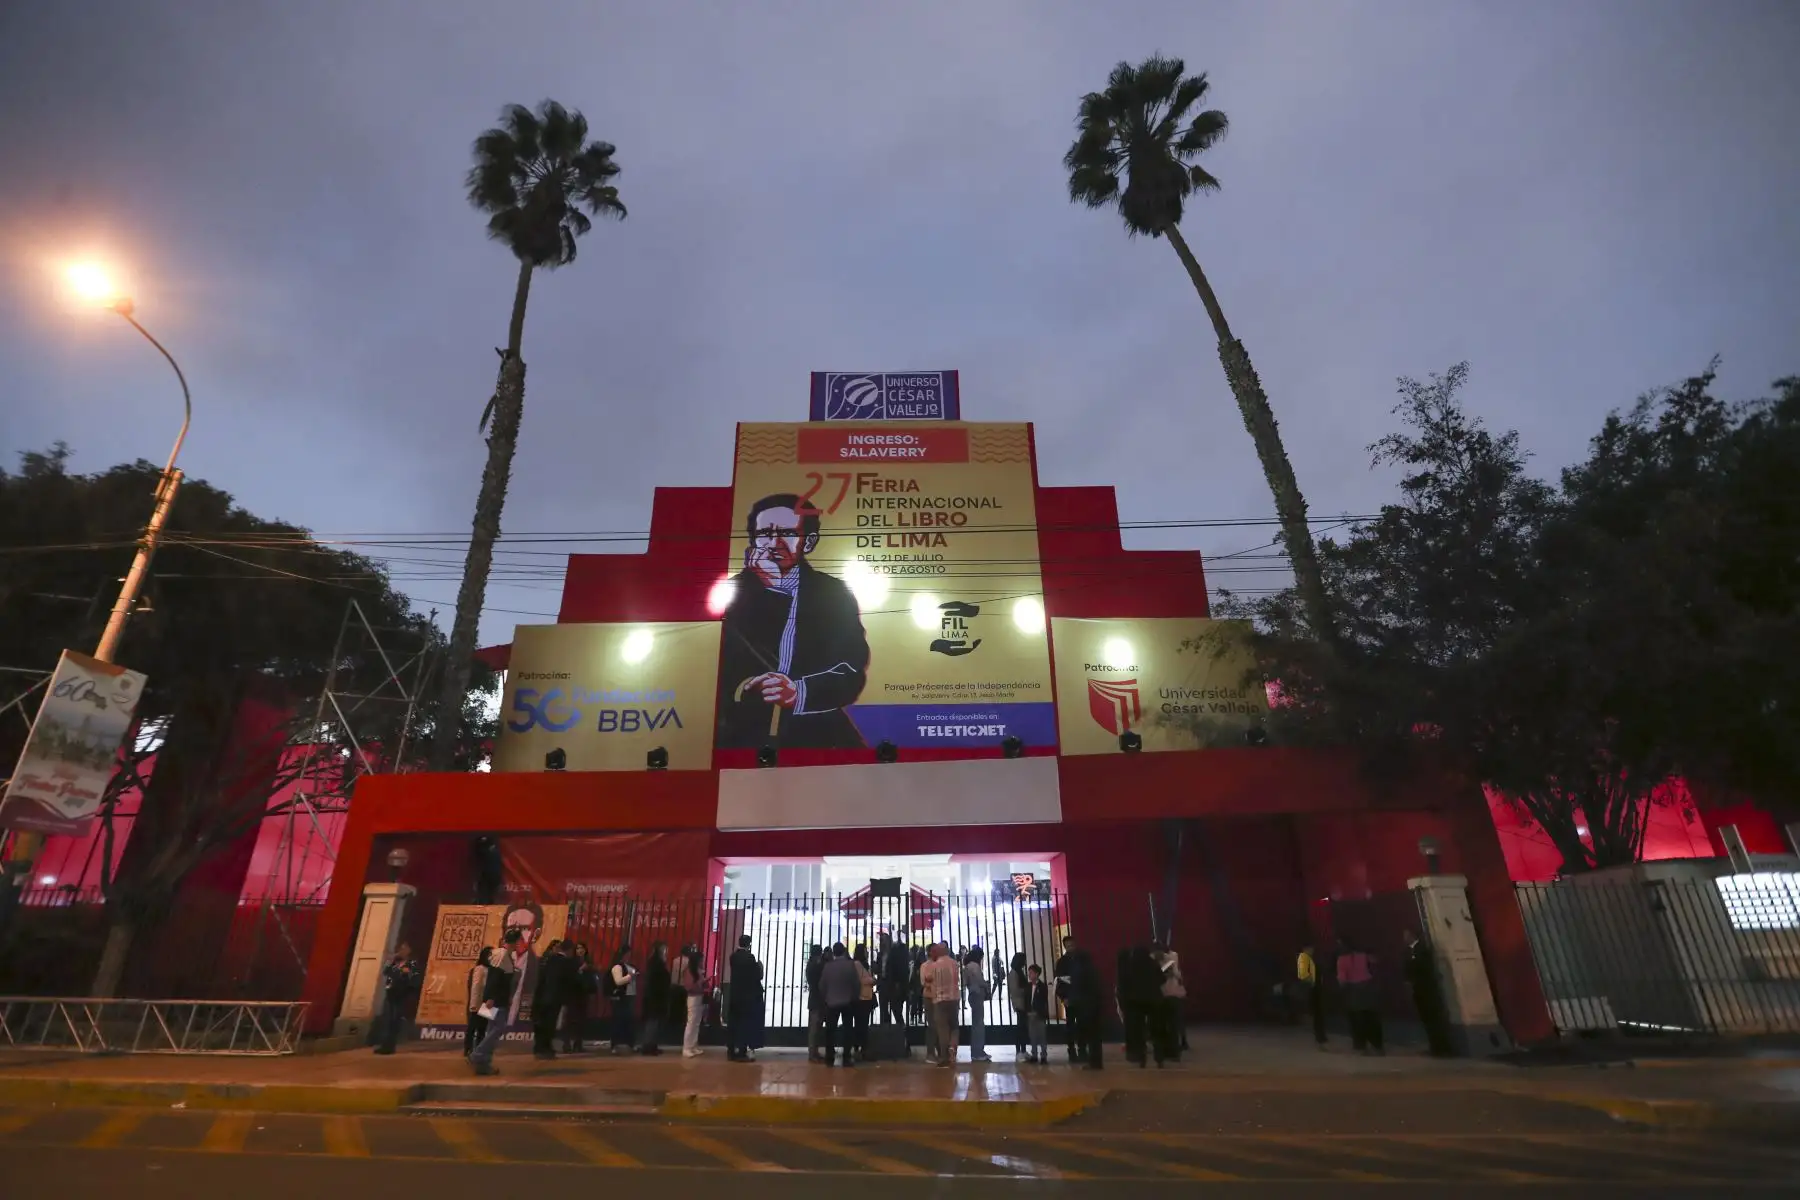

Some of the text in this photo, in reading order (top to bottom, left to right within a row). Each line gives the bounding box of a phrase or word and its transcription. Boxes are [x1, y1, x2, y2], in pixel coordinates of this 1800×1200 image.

[887, 377, 939, 387] UNIVERSO
[889, 387, 935, 401] CÉSAR
[889, 404, 938, 416] VALLEJO
[848, 435, 919, 445] INGRESO:
[840, 447, 927, 458] SALAVERRY
[794, 472, 853, 516] 27
[856, 497, 1003, 509] INTERNACIONAL
[856, 511, 969, 527] DEL LIBRO
[856, 531, 949, 549] DE LIMA
[857, 553, 945, 562] DEL 21 DE JULIO
[882, 565, 899, 575] DE
[899, 565, 946, 575] AGOSTO
[941, 617, 969, 630] FIL
[941, 630, 969, 639] LIMA
[518, 671, 571, 681] Patrocina:
[884, 684, 915, 692] Parque
[955, 682, 967, 690] de
[967, 682, 976, 690] la
[977, 681, 1041, 690] Independencia
[1159, 688, 1246, 699] Universidad
[1161, 700, 1204, 714] César
[598, 707, 683, 732] BBVA
[949, 713, 988, 722] disponibles
[918, 725, 1006, 737] TELETICKET
[442, 926, 482, 942] CÉSAR
